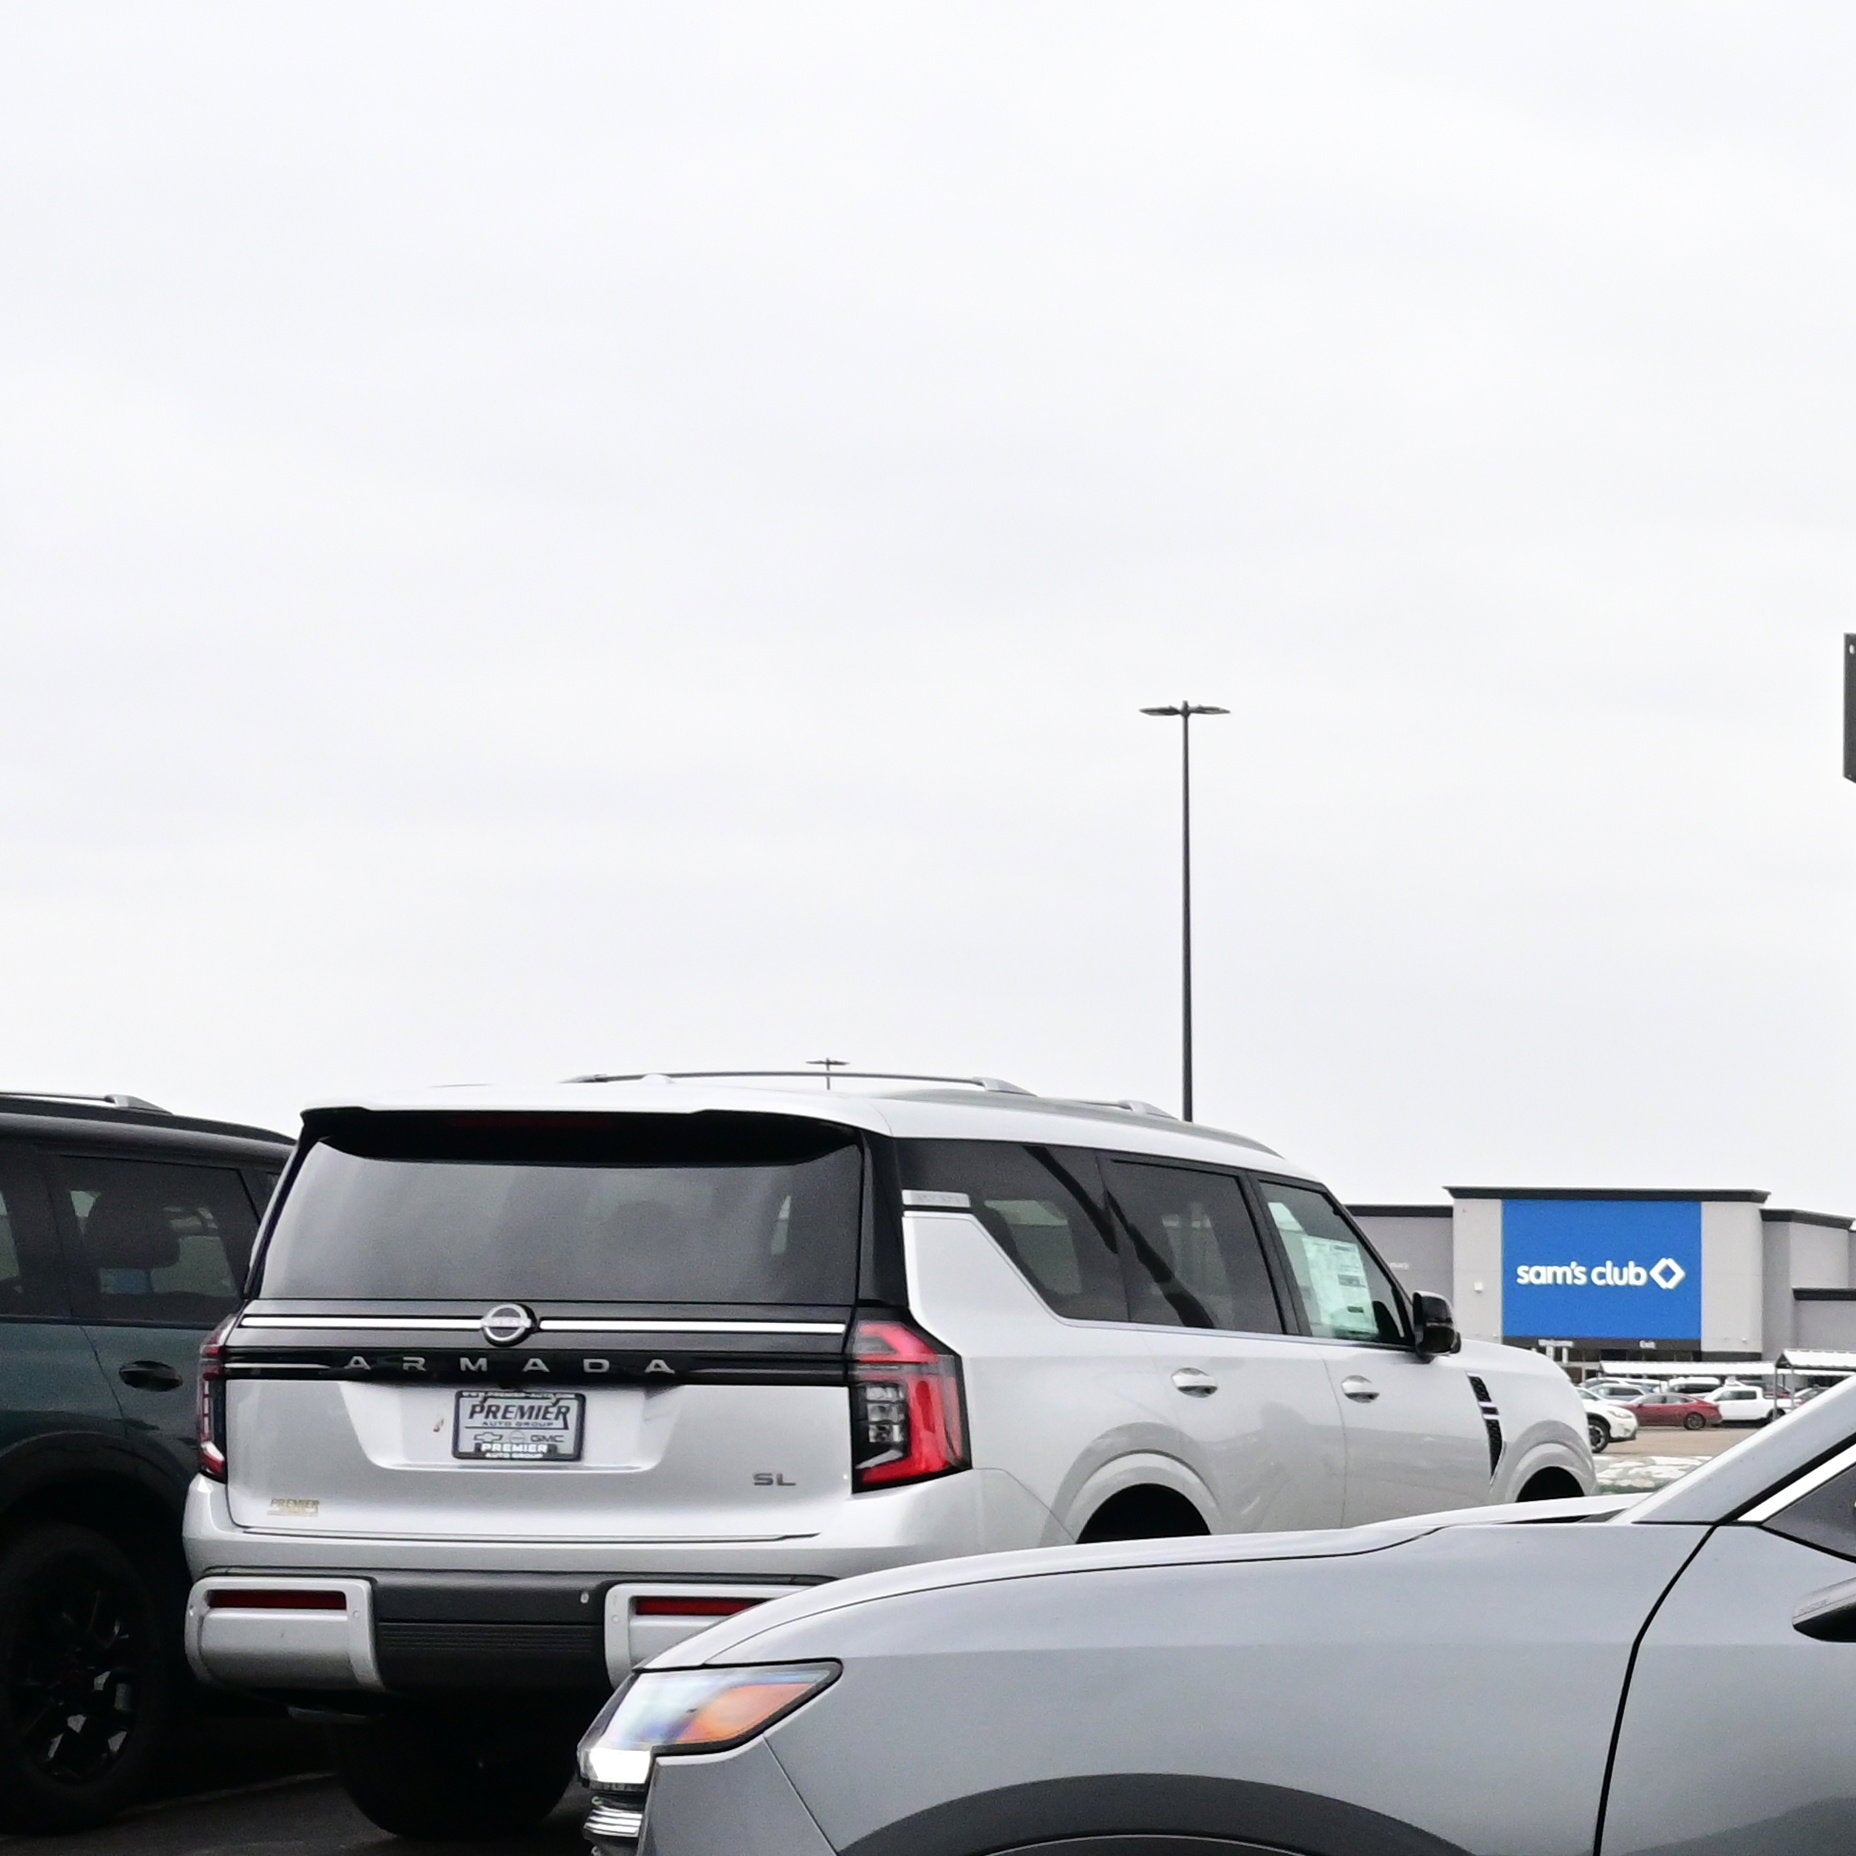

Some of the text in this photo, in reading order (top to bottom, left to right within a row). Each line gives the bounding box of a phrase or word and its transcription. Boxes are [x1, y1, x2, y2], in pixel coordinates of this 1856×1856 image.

[1515, 1260, 1649, 1287] sam's club
[344, 1356, 676, 1375] ARMADA
[468, 1403, 571, 1424] PREMIER
[529, 1434, 565, 1443] GMC
[480, 1443, 549, 1454] PREMIER
[753, 1472, 797, 1486] SL
